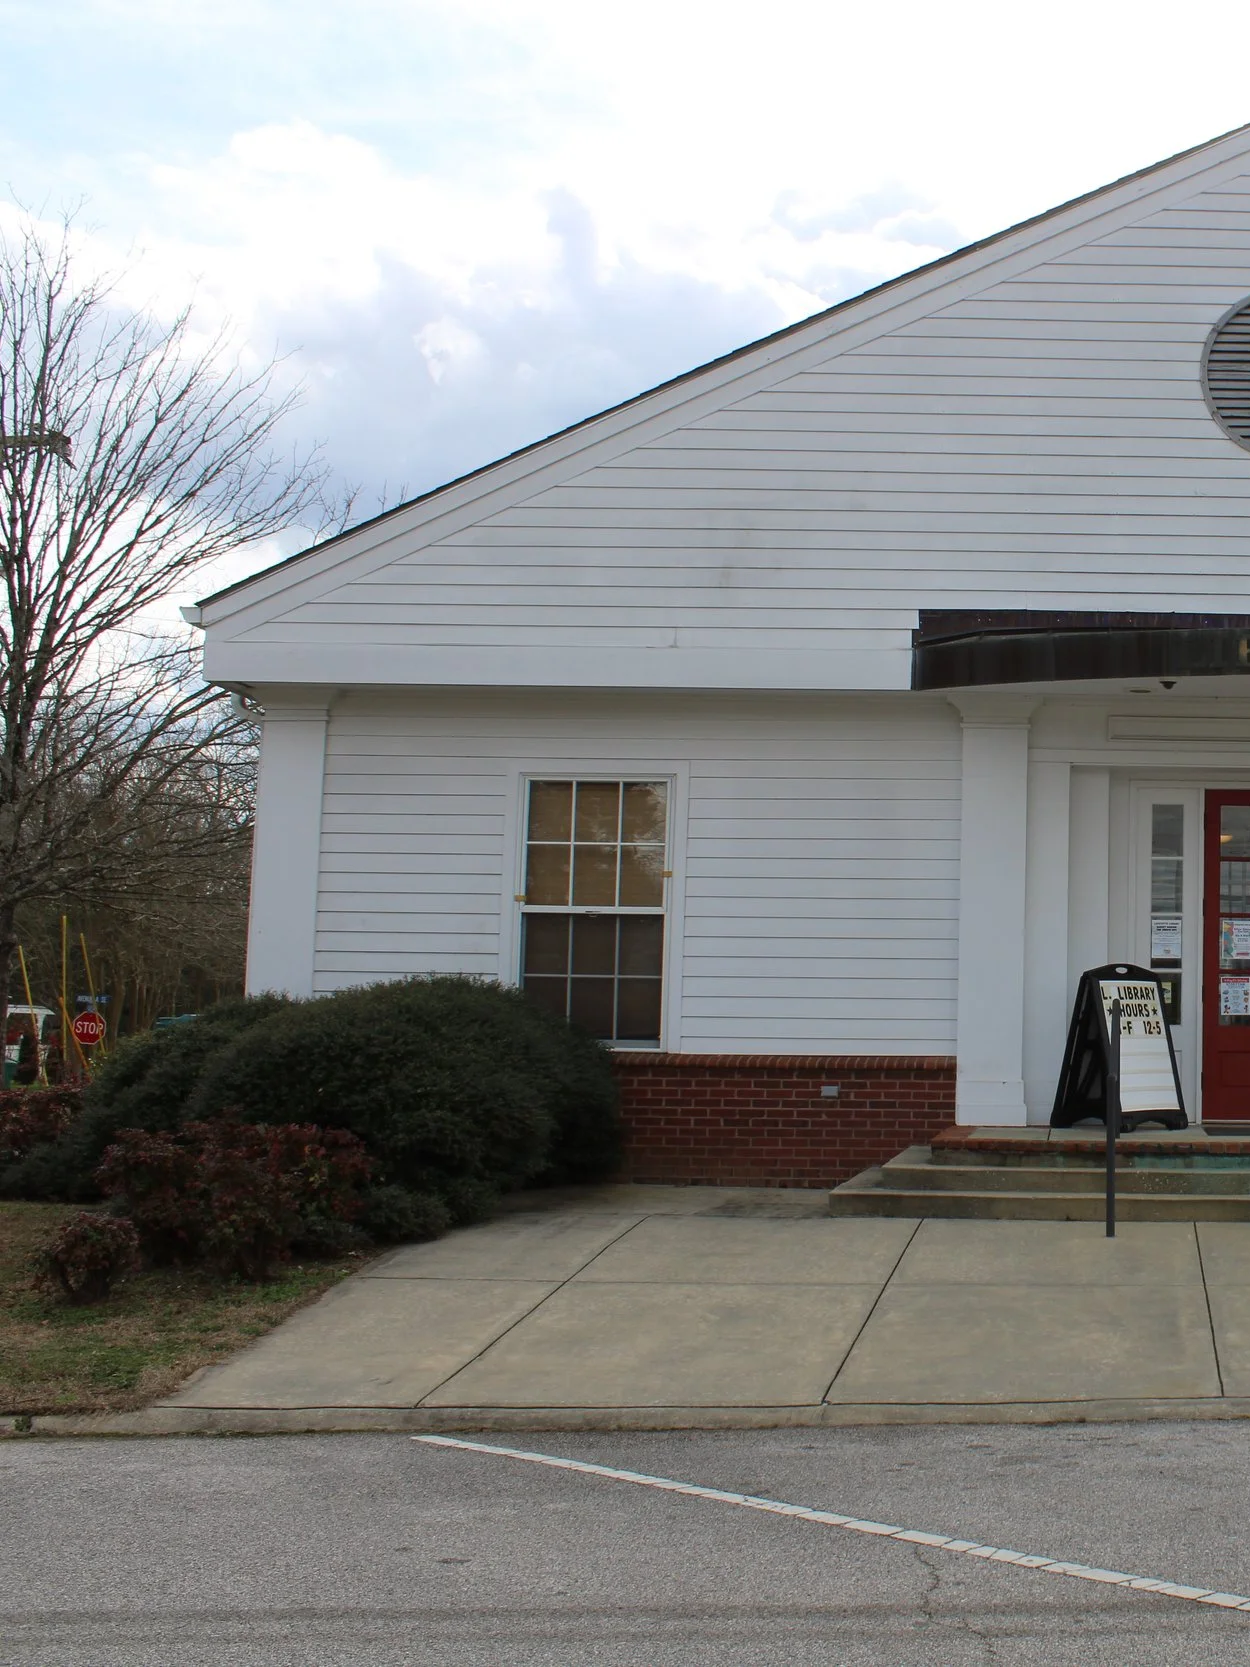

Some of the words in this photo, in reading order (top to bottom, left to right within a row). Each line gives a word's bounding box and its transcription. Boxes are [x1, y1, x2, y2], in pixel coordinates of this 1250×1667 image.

[1101, 986, 1112, 1000] L.
[1117, 986, 1155, 1000] LIBRARY
[1119, 1003, 1150, 1018] HOURS
[75, 1021, 104, 1034] STOP
